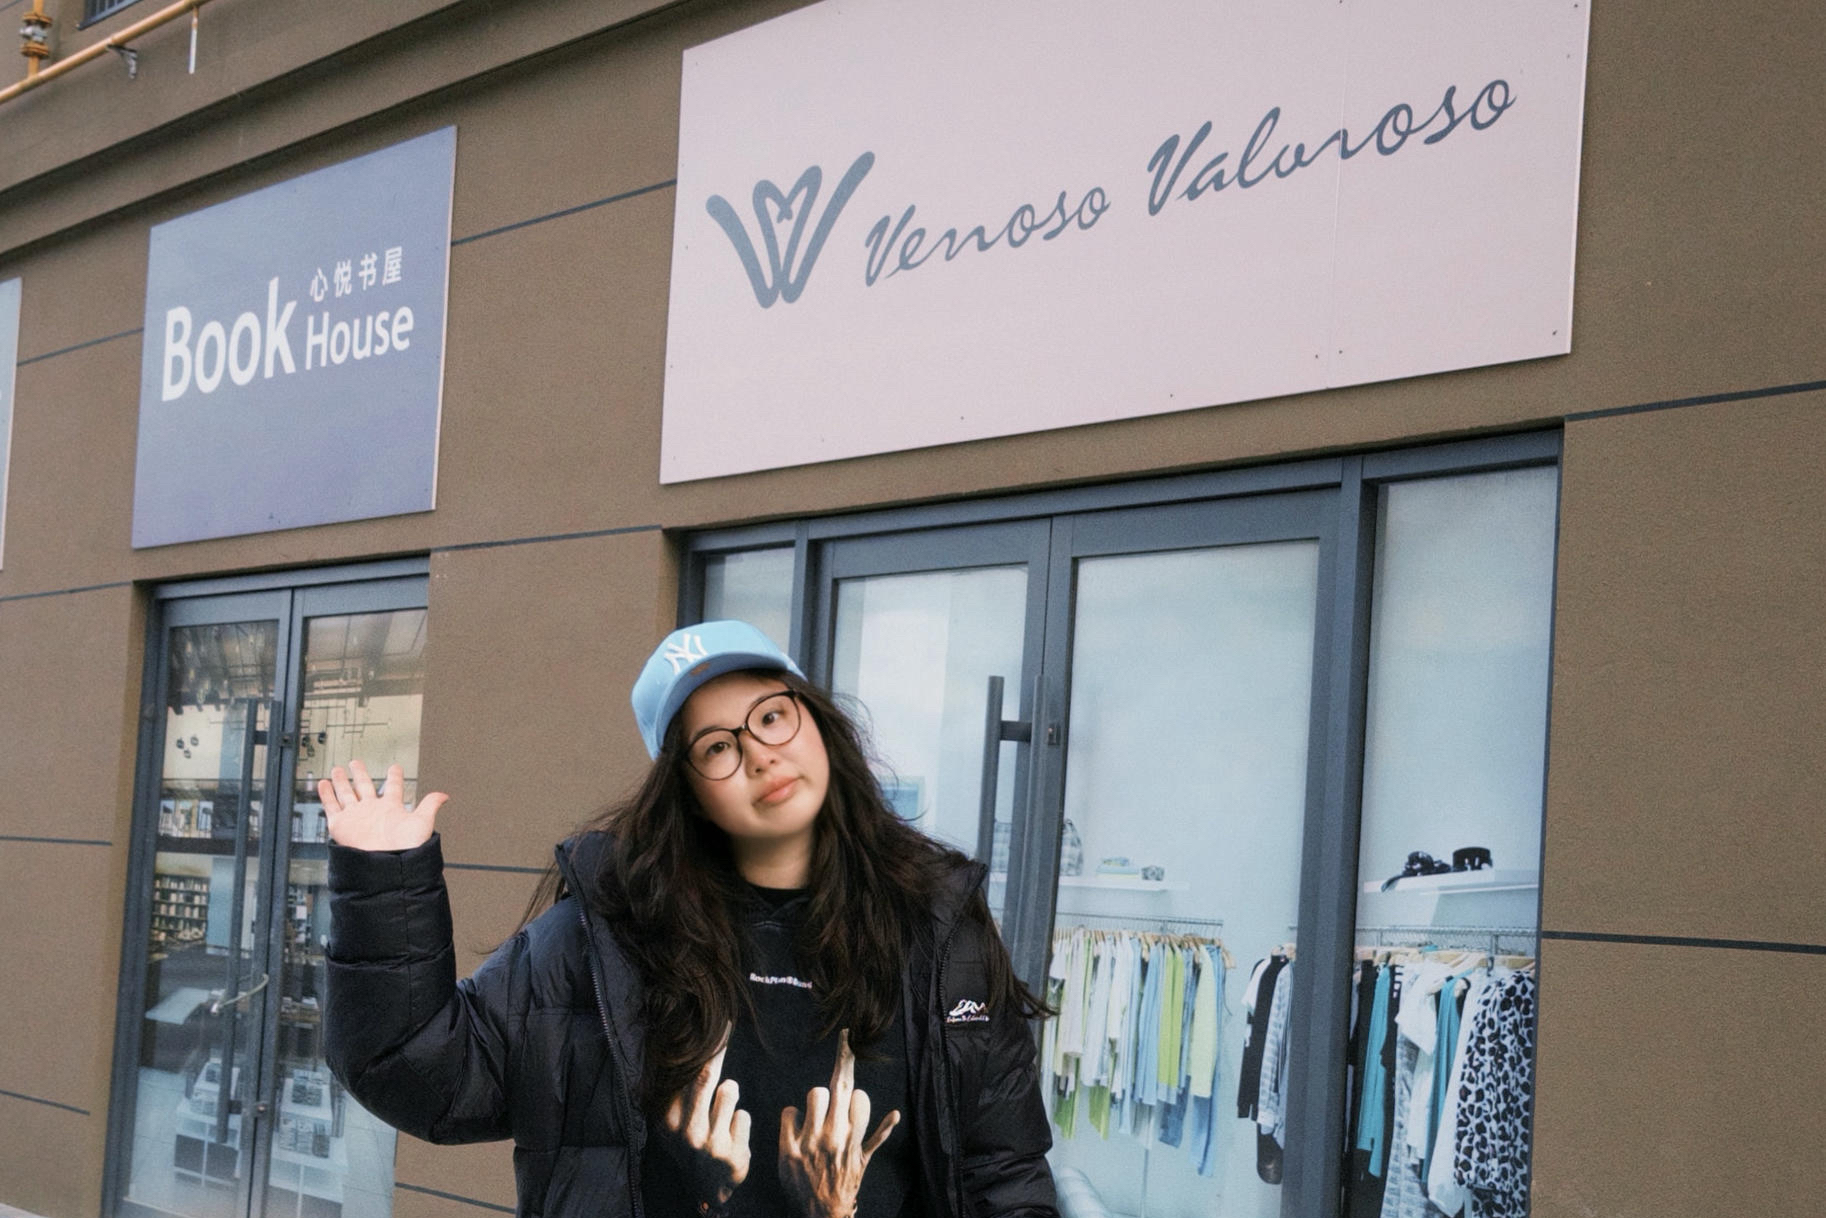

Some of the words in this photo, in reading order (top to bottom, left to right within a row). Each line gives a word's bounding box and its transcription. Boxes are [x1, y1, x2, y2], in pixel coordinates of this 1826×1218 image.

[309, 245, 403, 303] 心悦书屋
[865, 187, 1112, 287] Venoso
[161, 276, 298, 402] Book
[305, 306, 414, 371] House
[664, 633, 709, 675] NY
